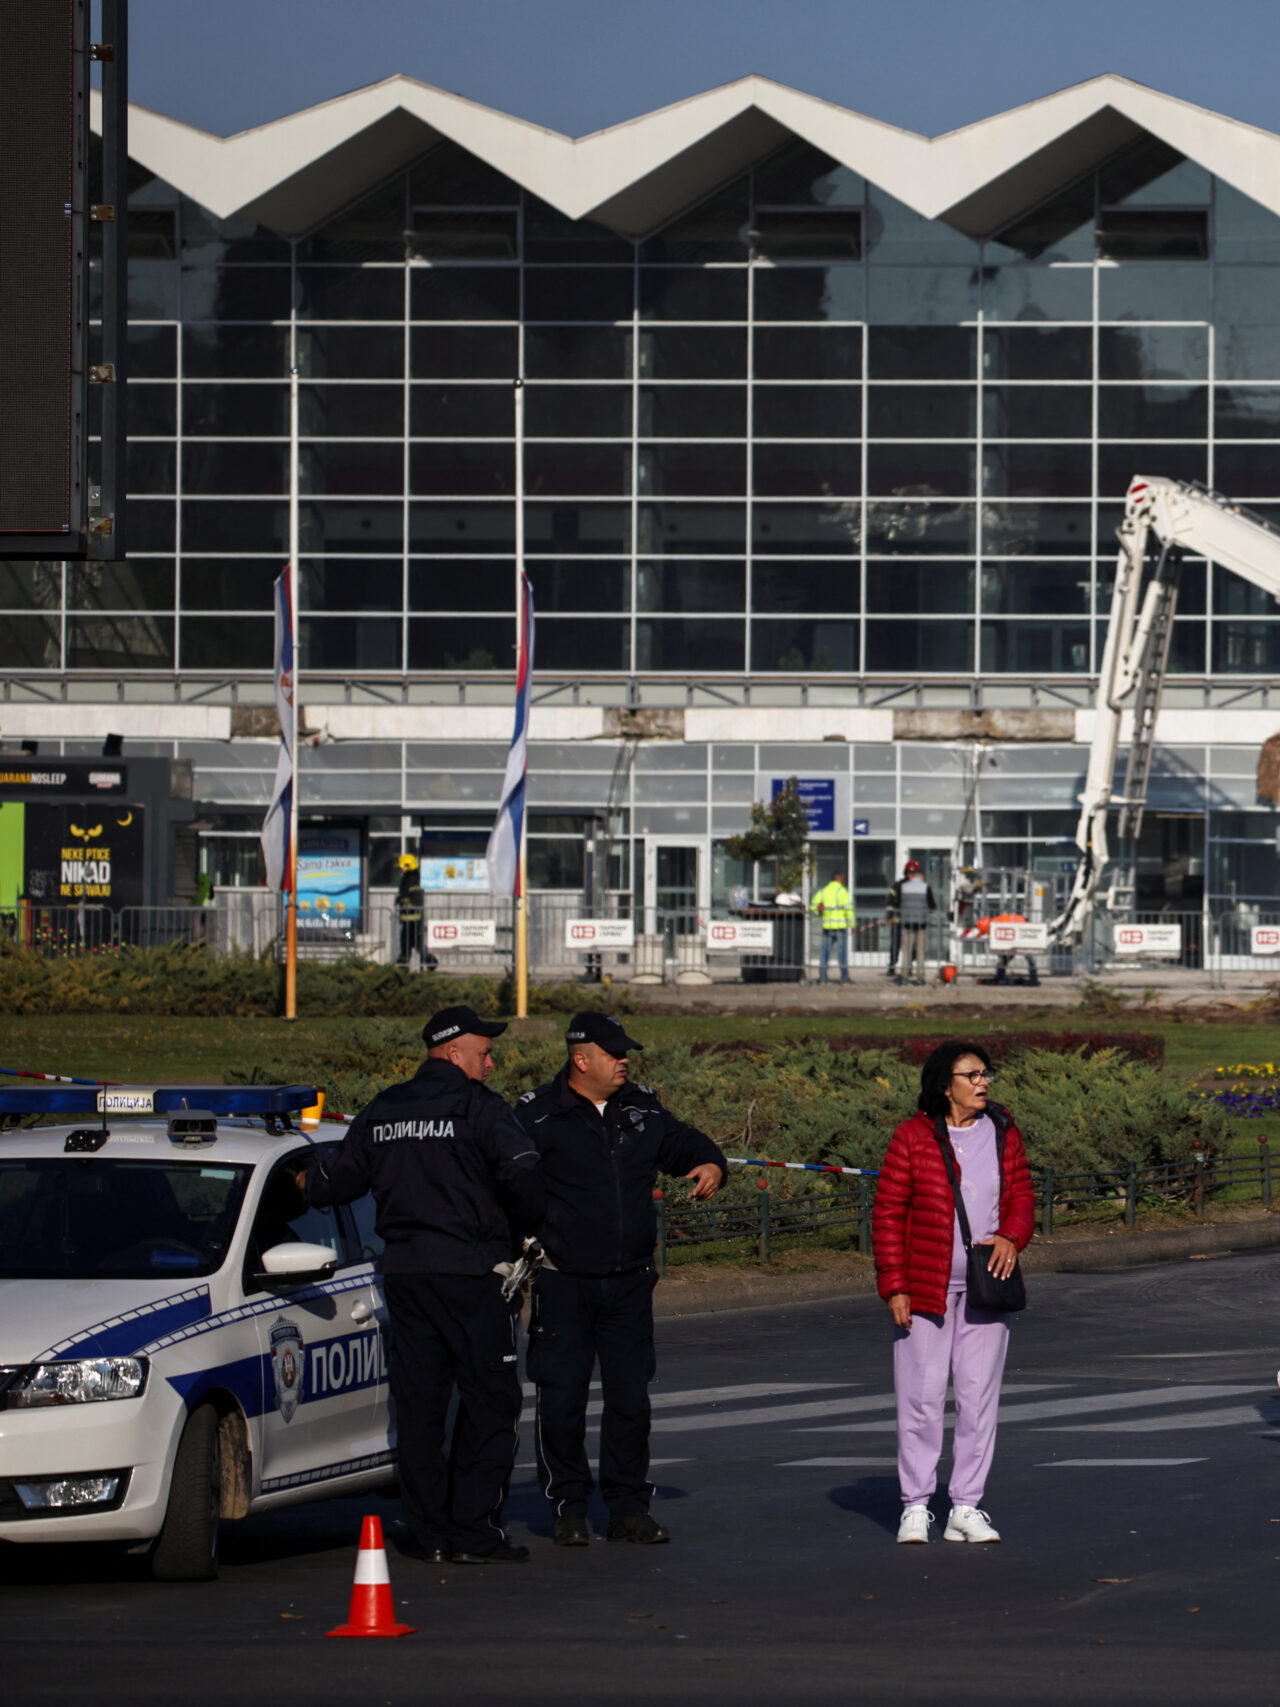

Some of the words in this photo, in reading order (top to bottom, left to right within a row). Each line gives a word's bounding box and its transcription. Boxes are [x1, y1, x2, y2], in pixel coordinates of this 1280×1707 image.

[61, 848, 84, 860] NEKE
[86, 848, 110, 860] PTICE
[60, 884, 73, 896] NE
[99, 1096, 152, 1110] ПОЛИЦИЈА
[373, 1120, 455, 1142] ПОЛИЦИЈА
